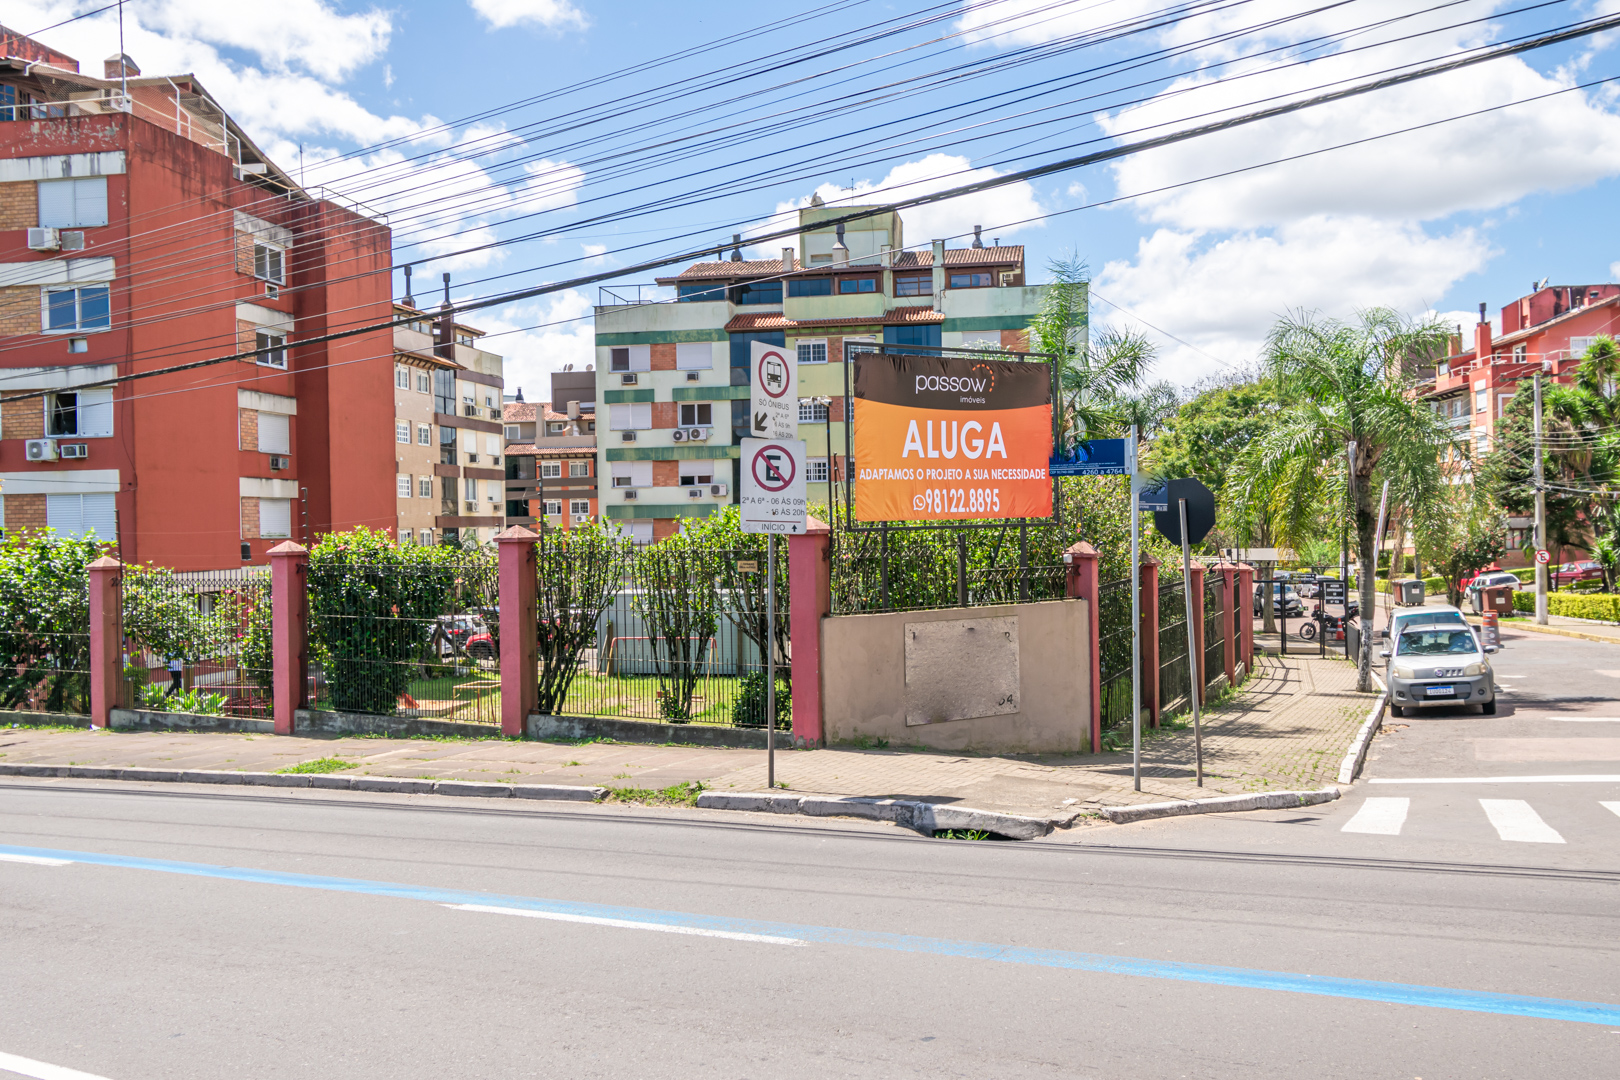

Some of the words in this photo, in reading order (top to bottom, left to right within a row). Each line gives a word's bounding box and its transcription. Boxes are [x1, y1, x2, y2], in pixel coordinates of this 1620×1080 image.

[914, 374, 987, 394] passow
[768, 399, 790, 410] ÔNIBUS
[959, 396, 986, 404] imóveis
[901, 419, 1008, 460] ALUGA
[859, 468, 915, 480] ADAPTAMOS
[916, 468, 924, 480] O
[926, 468, 963, 480] PROJETO
[965, 468, 973, 480] A
[973, 468, 990, 480] SUA
[991, 468, 1046, 480] NECESSIDADE
[781, 497, 791, 506] ÀS
[792, 498, 806, 506] 09h
[925, 488, 1000, 514] 98122.8895
[780, 507, 791, 516] ÀS
[761, 522, 786, 531] INÍCIO
